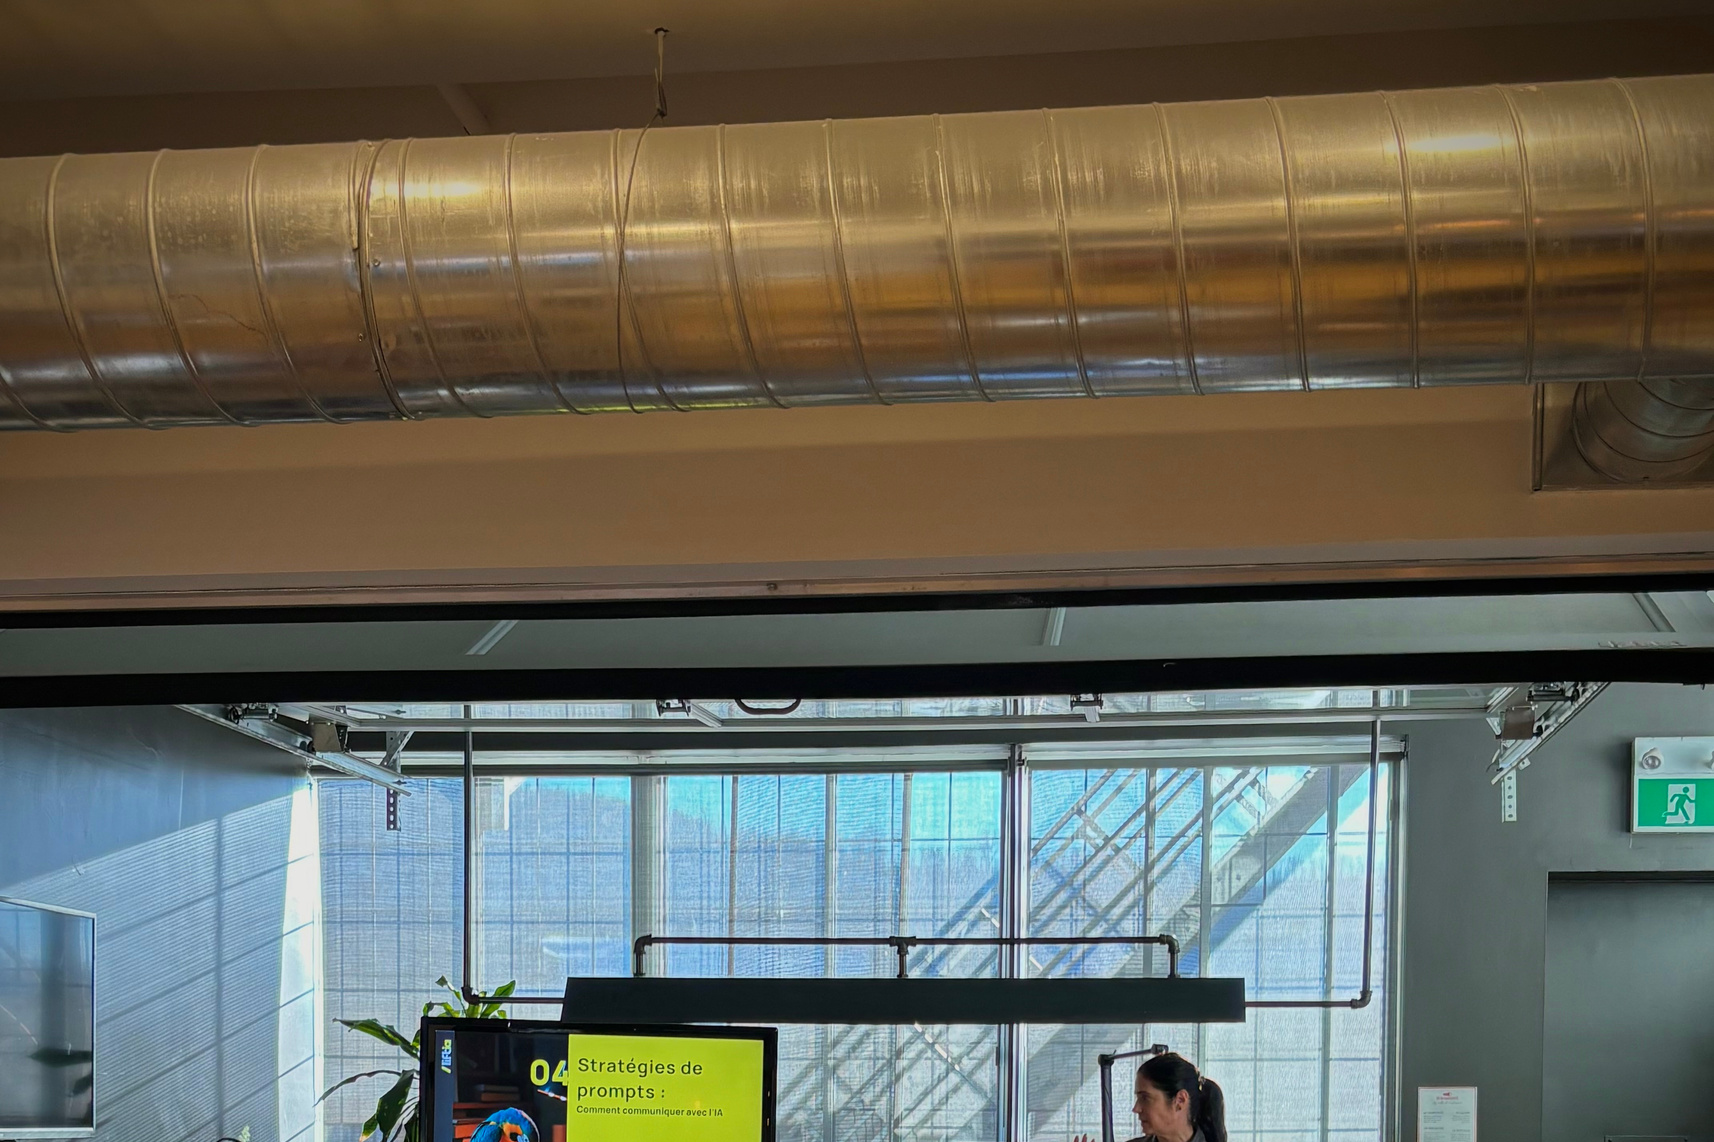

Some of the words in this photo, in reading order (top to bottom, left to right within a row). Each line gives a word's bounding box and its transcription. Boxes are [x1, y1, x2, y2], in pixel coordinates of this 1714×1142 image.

[530, 1059, 568, 1087] 04
[578, 1057, 676, 1078] Stratégies
[681, 1061, 703, 1075] de
[577, 1085, 655, 1102] prompts
[576, 1105, 620, 1114] Comment
[622, 1107, 684, 1117] communiquer
[686, 1108, 707, 1117] avec
